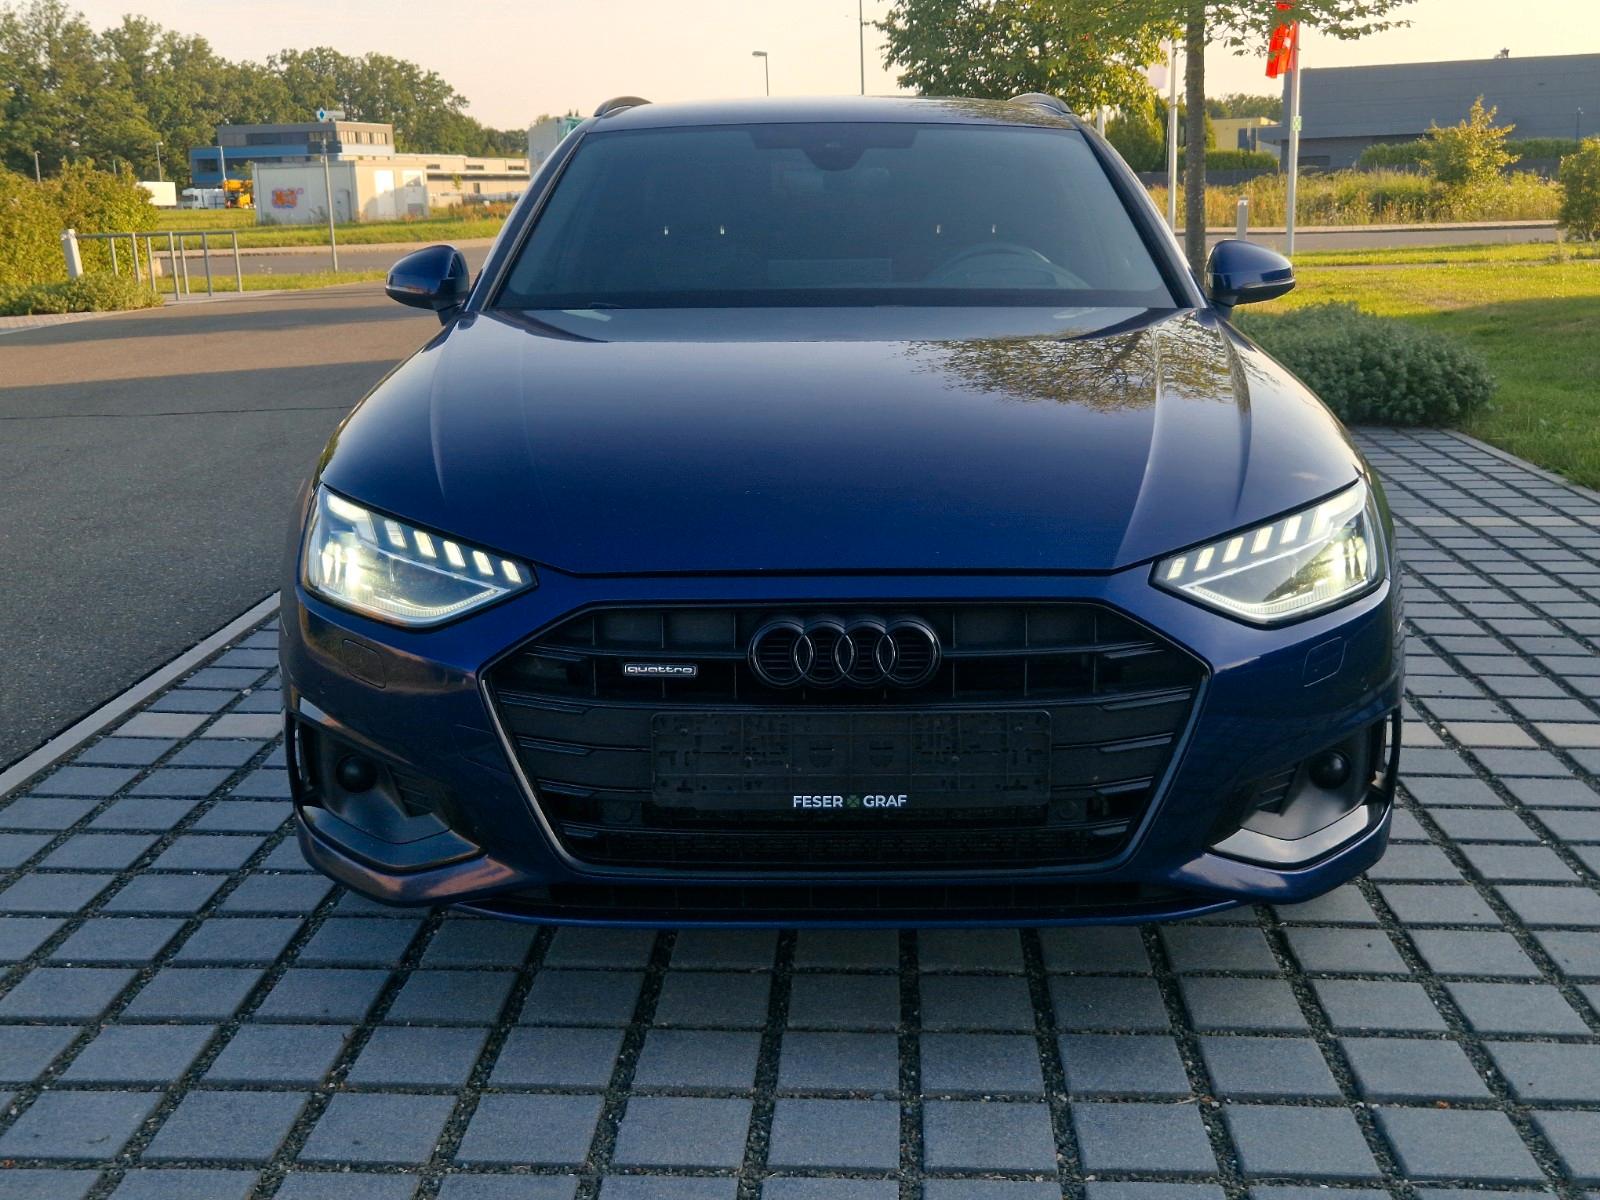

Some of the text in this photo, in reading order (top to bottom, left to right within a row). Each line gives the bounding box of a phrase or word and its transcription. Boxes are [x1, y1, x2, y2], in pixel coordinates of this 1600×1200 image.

[626, 665, 694, 674] quattro
[793, 794, 908, 808] FESER GRAF
